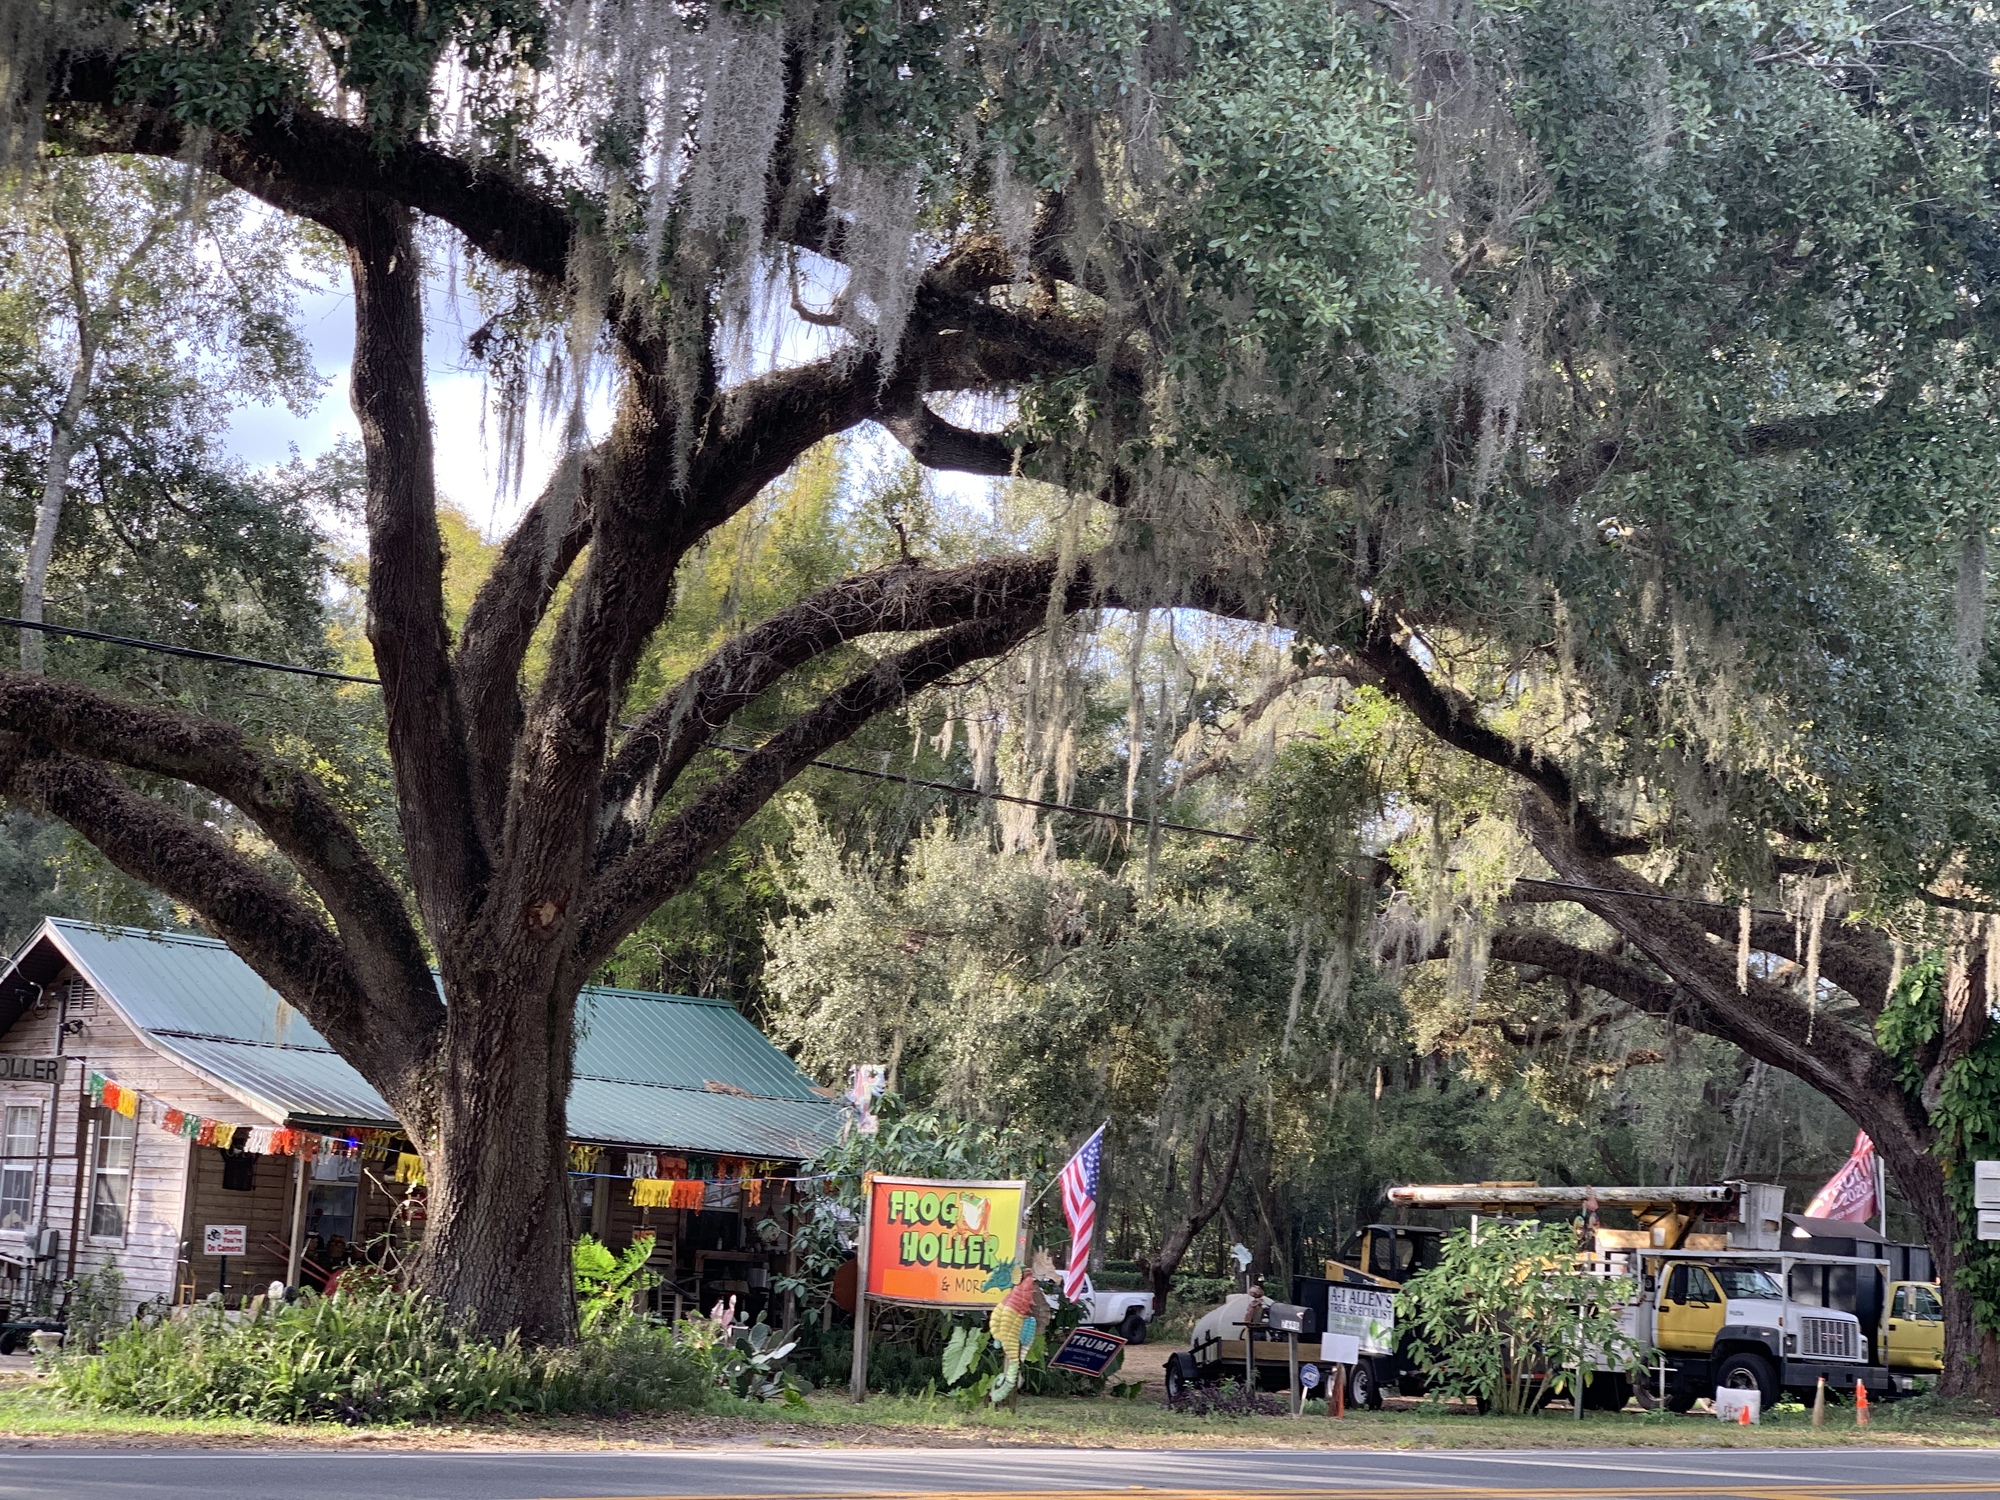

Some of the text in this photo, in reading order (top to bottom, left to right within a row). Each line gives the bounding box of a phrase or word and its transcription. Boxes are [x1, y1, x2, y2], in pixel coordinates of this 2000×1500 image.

[1842, 1181, 1868, 1206] 2020
[888, 1190, 959, 1228] FROG
[900, 1231, 1000, 1273] HOLLER
[941, 1276, 951, 1292] &
[1331, 1288, 1393, 1309] A-1 ALLEN'S
[1330, 1302, 1347, 1314] TREE
[1349, 1305, 1393, 1320] SPECIALIST
[1070, 1335, 1116, 1353] TRUMP
